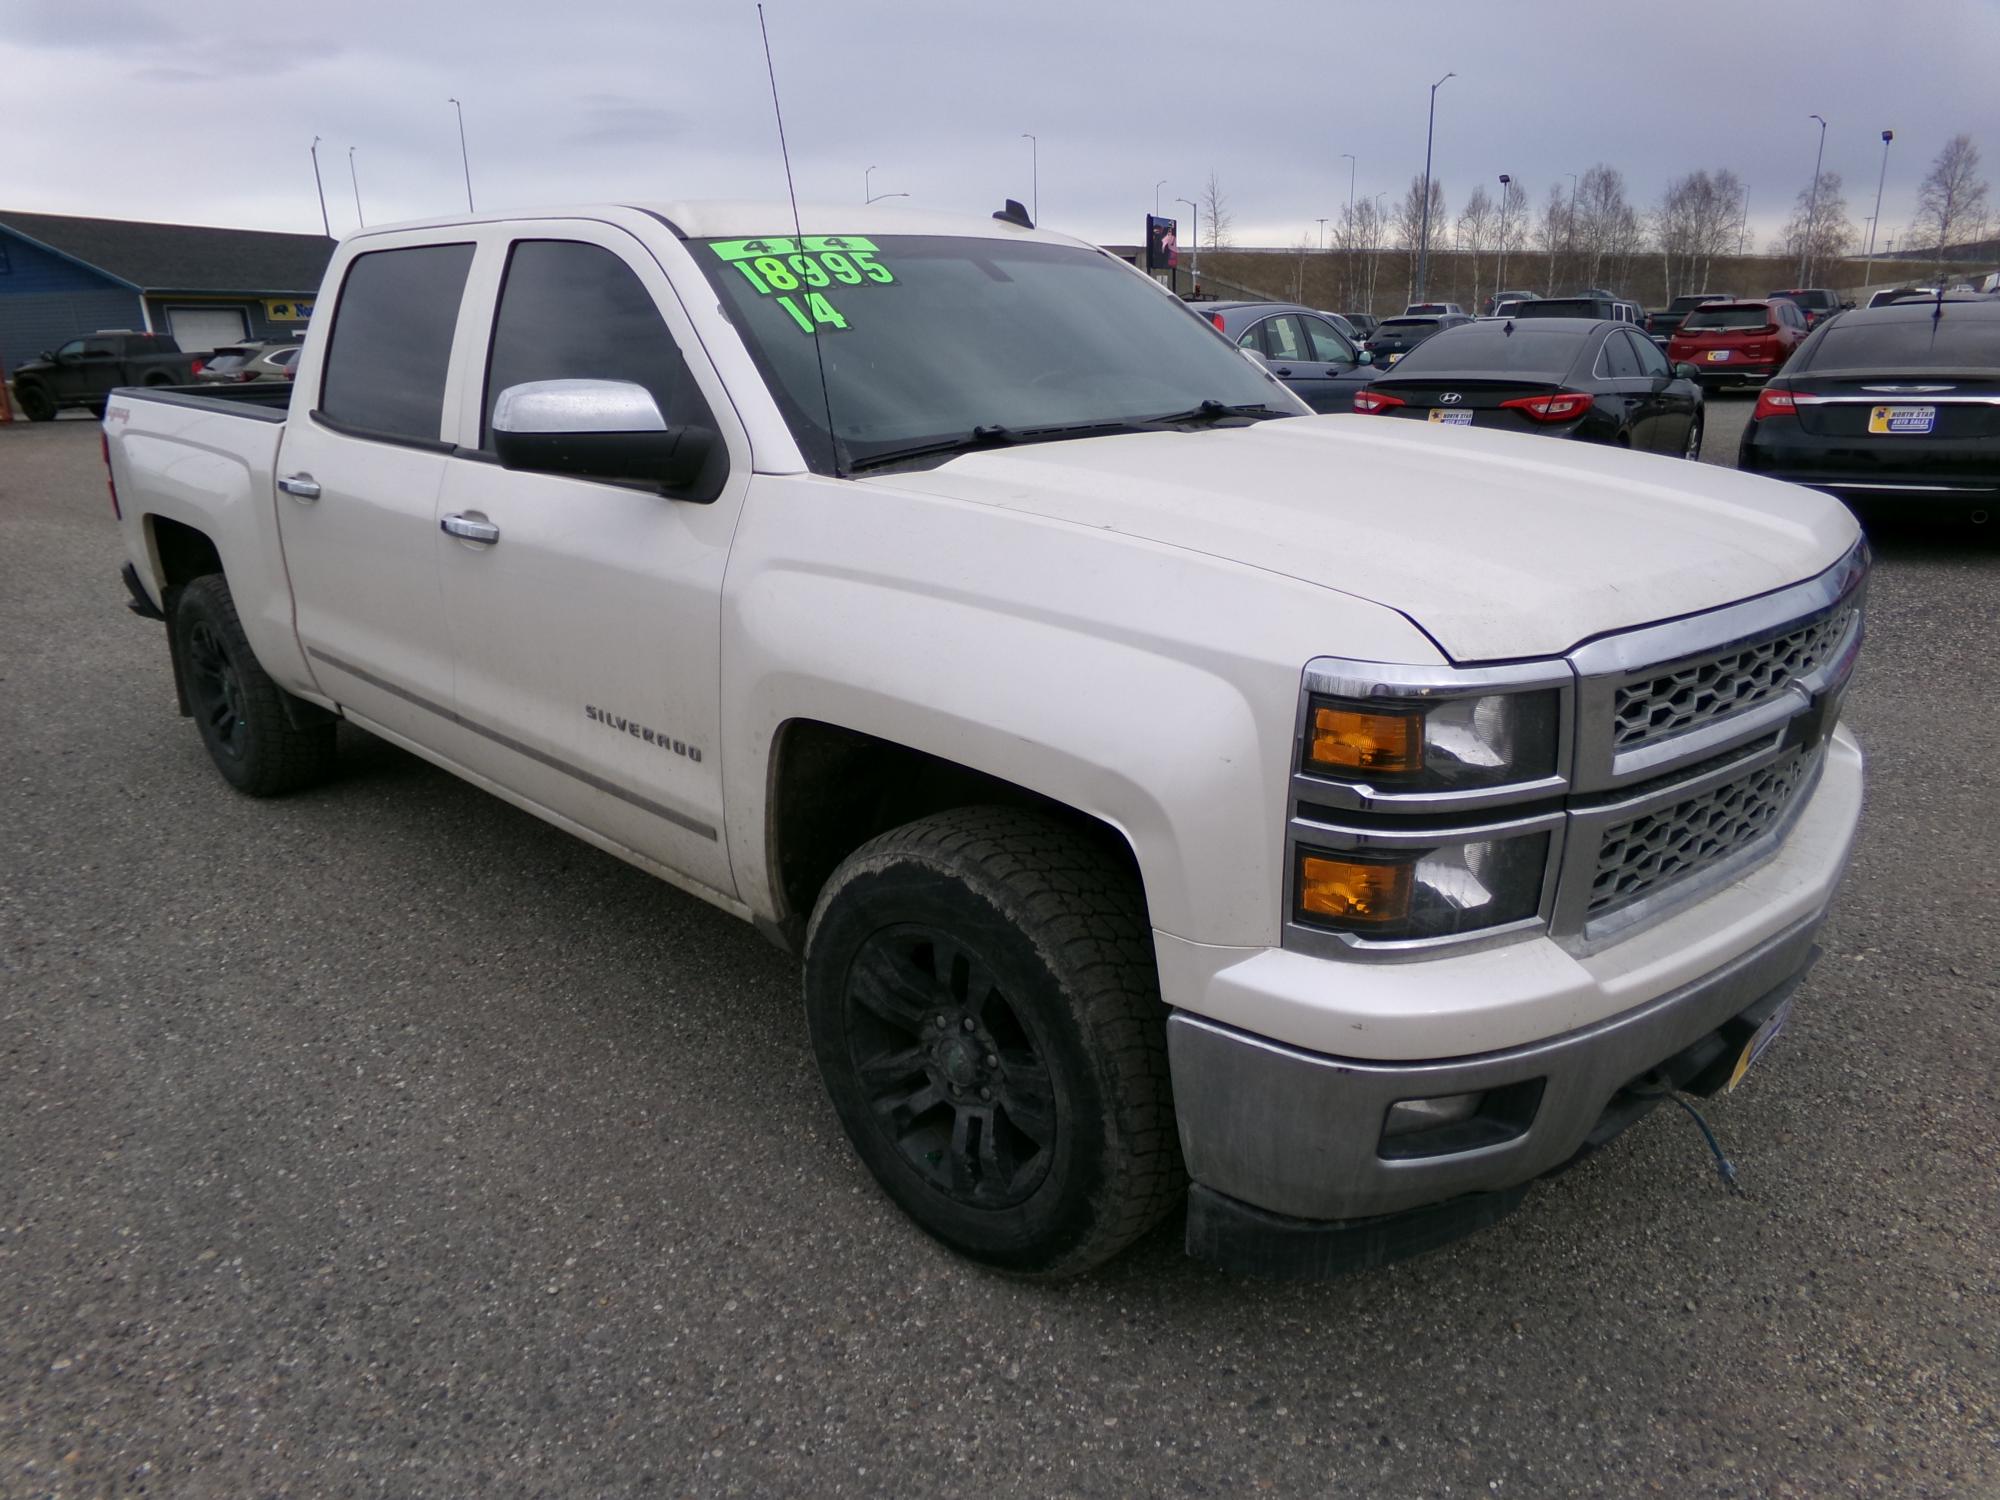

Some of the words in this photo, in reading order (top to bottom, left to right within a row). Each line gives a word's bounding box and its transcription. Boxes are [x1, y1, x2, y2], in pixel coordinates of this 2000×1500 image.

[733, 251, 894, 294] 18995
[775, 292, 848, 333] 14
[585, 703, 702, 763] SILVERADO
